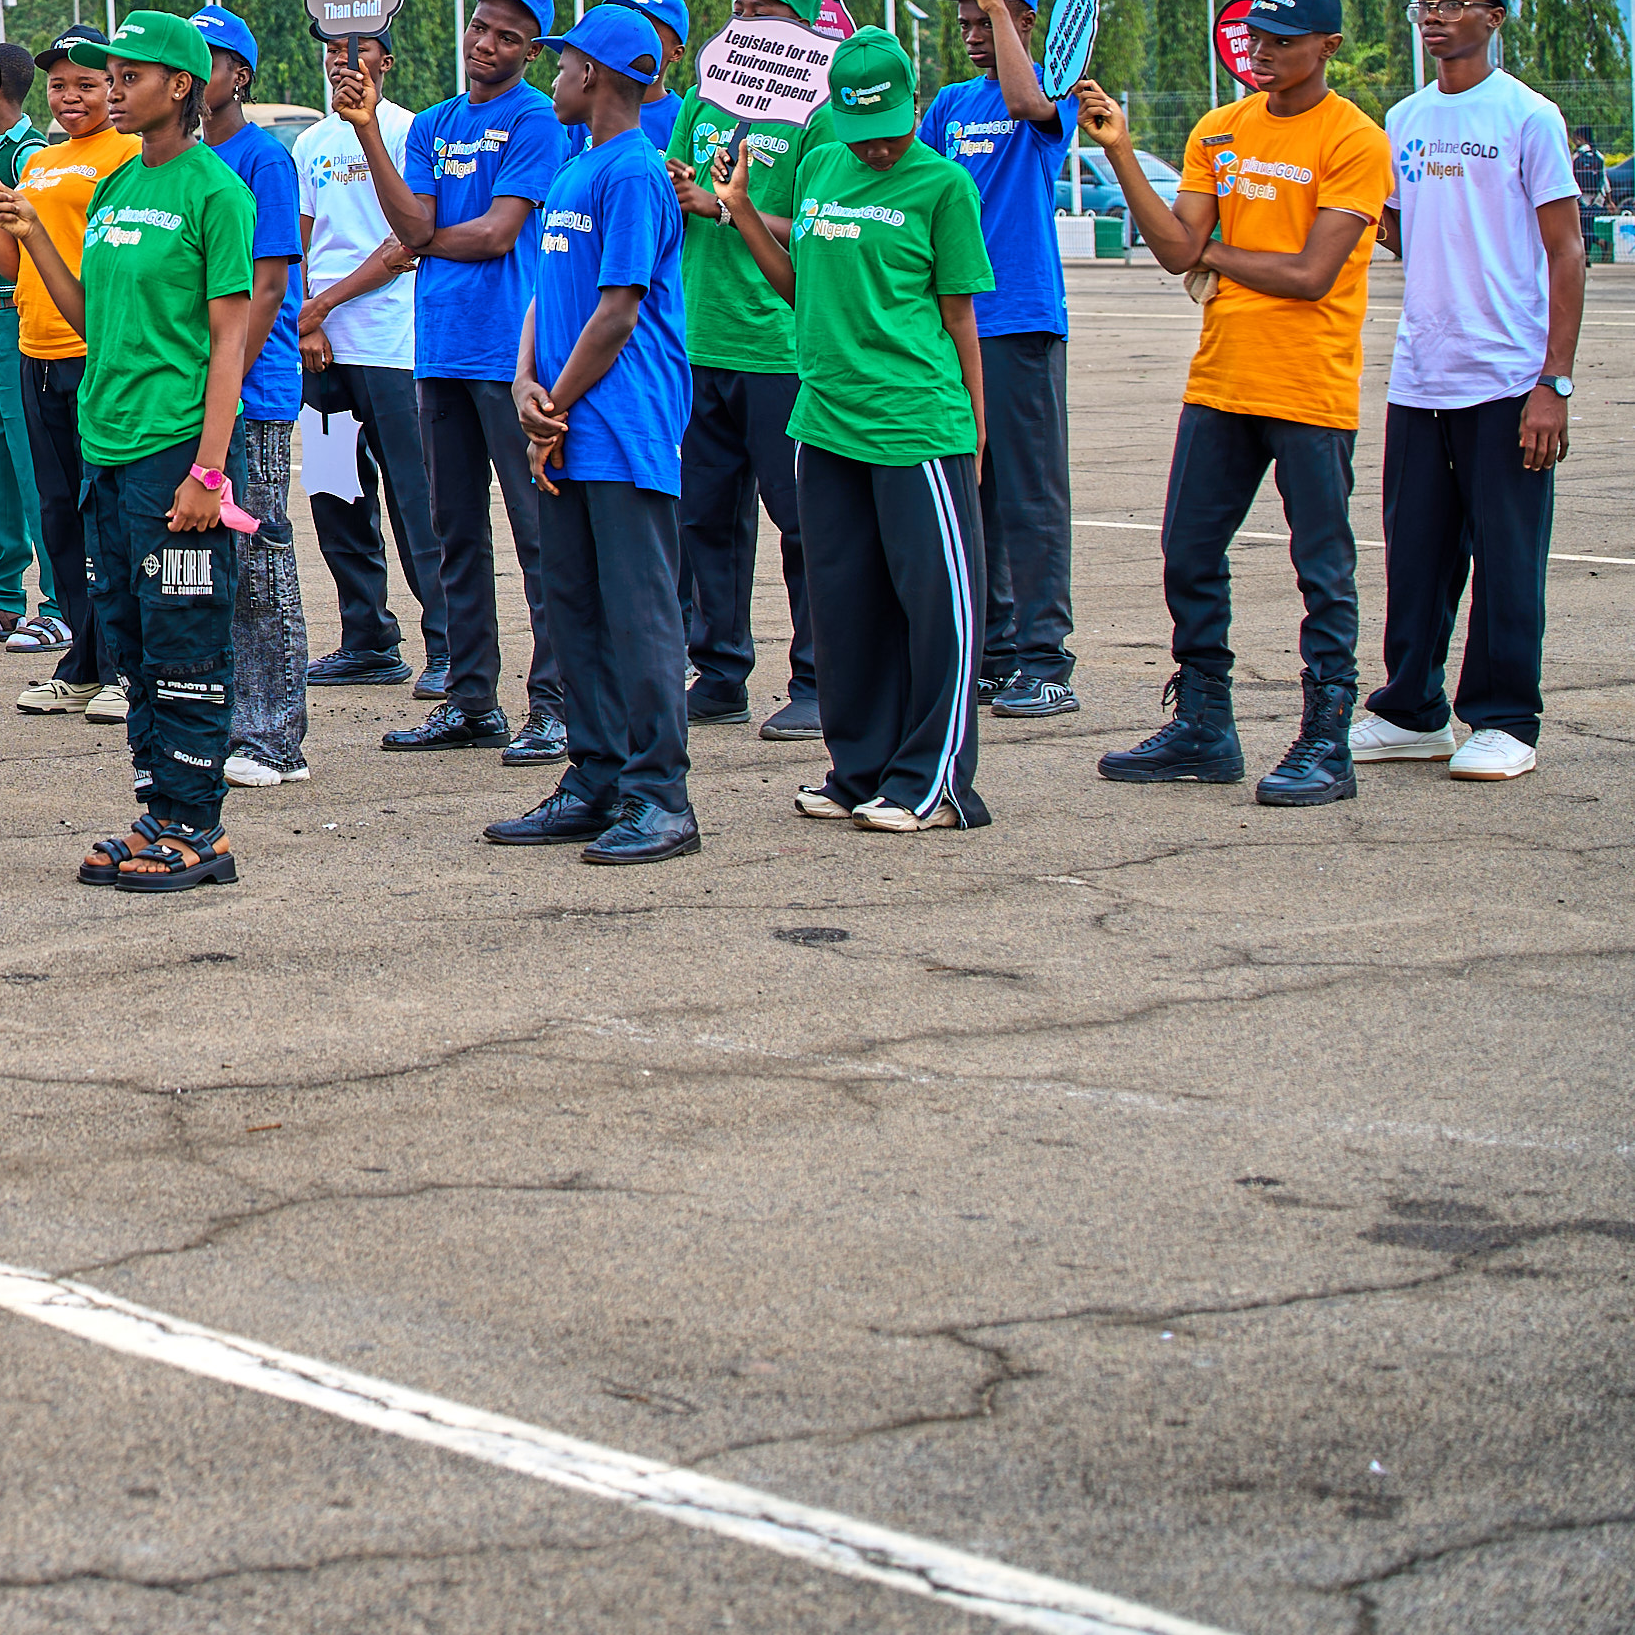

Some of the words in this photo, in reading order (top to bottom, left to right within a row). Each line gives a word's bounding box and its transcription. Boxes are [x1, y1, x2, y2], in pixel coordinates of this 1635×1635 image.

[324, 2, 350, 21] Than
[353, 0, 381, 17] Gold!
[725, 29, 784, 56] Legislate
[785, 45, 806, 62] for
[807, 50, 829, 66] the
[726, 50, 812, 82] Environment:
[707, 64, 730, 82] Our
[731, 70, 764, 91] Lives
[766, 79, 817, 103] Depend
[736, 94, 752, 107] on
[754, 97, 771, 111] It!
[1427, 161, 1465, 178] Nigeria
[1236, 177, 1277, 201] Nigeria
[114, 206, 181, 230] planetGOLD
[820, 201, 905, 226] planetGOLD
[104, 226, 142, 247] Nigeria
[813, 218, 861, 240] Nigeria
[178, 586, 212, 595] CONNECTION
[173, 750, 212, 767] SQUAD
